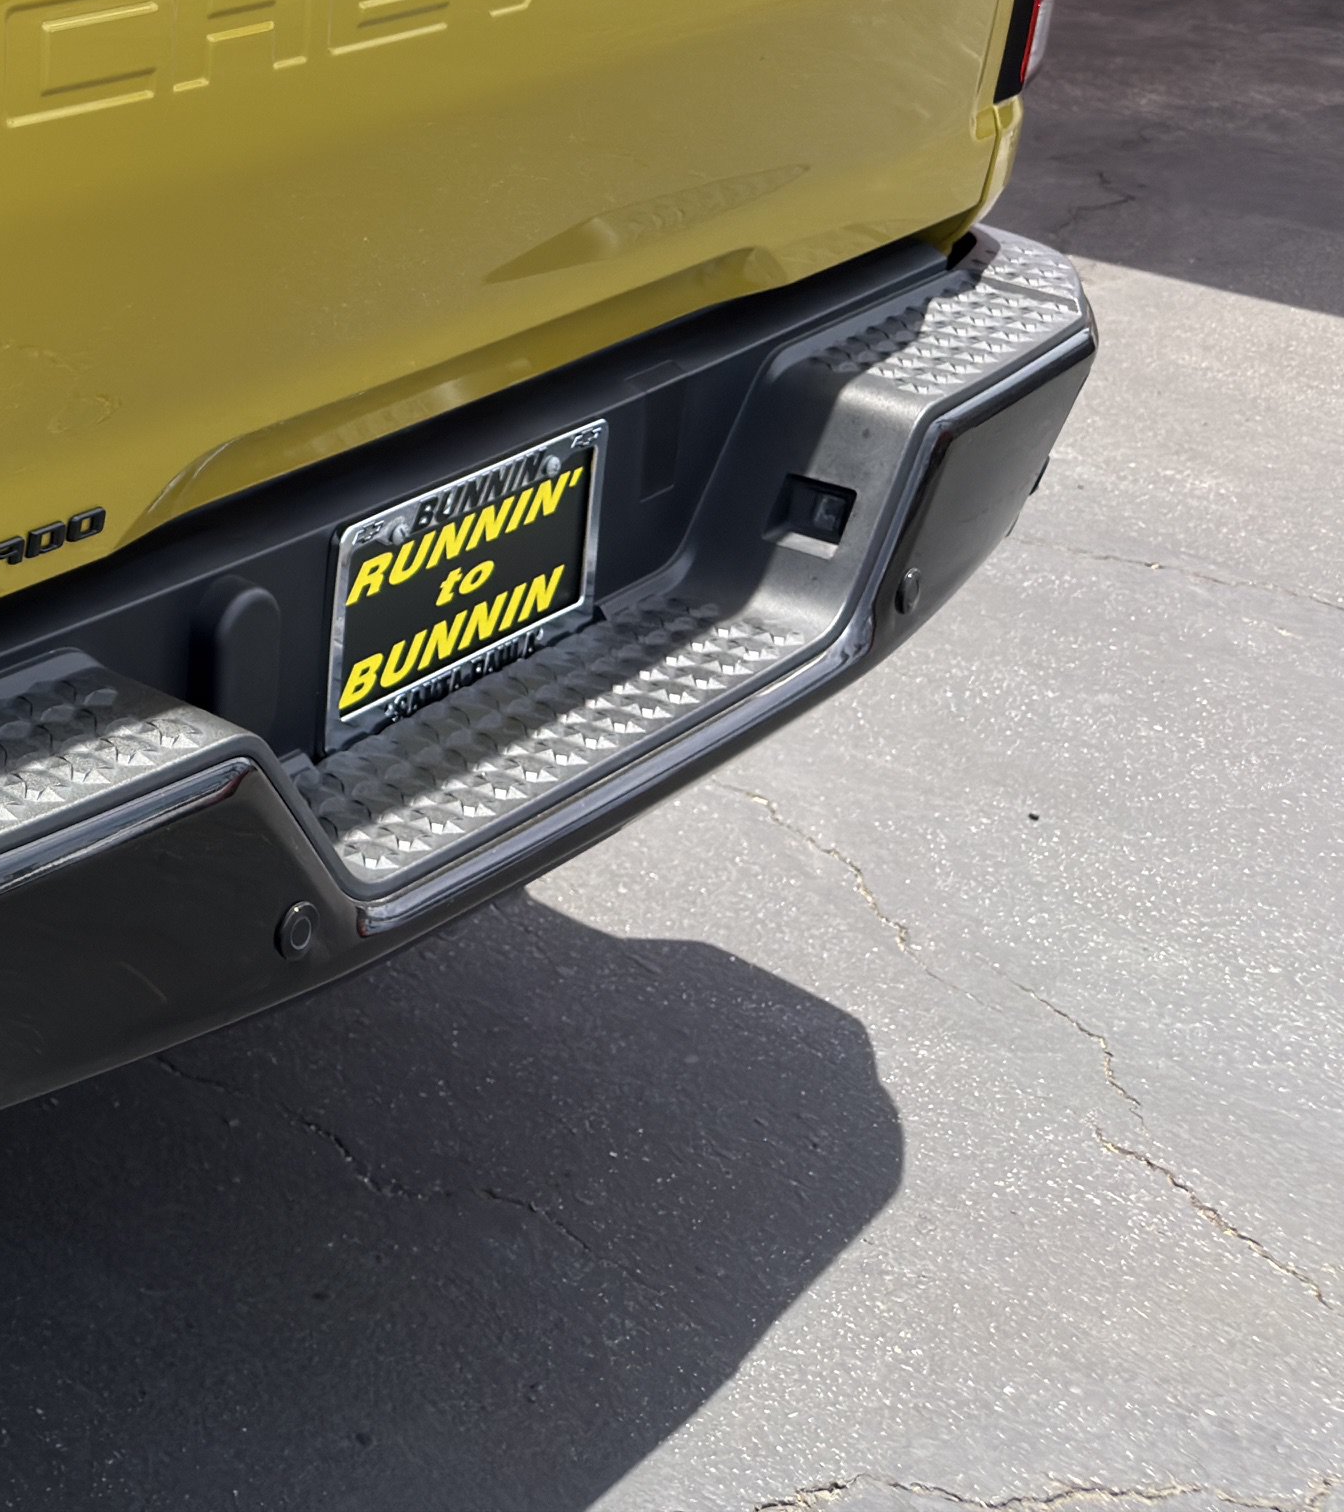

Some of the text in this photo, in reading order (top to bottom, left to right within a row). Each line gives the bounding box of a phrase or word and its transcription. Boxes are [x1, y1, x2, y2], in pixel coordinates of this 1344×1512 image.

[345, 467, 584, 607] RUNNIN'
[413, 448, 546, 529] BUNNIN
[338, 563, 566, 710] BUNNIN
[435, 560, 495, 607] to
